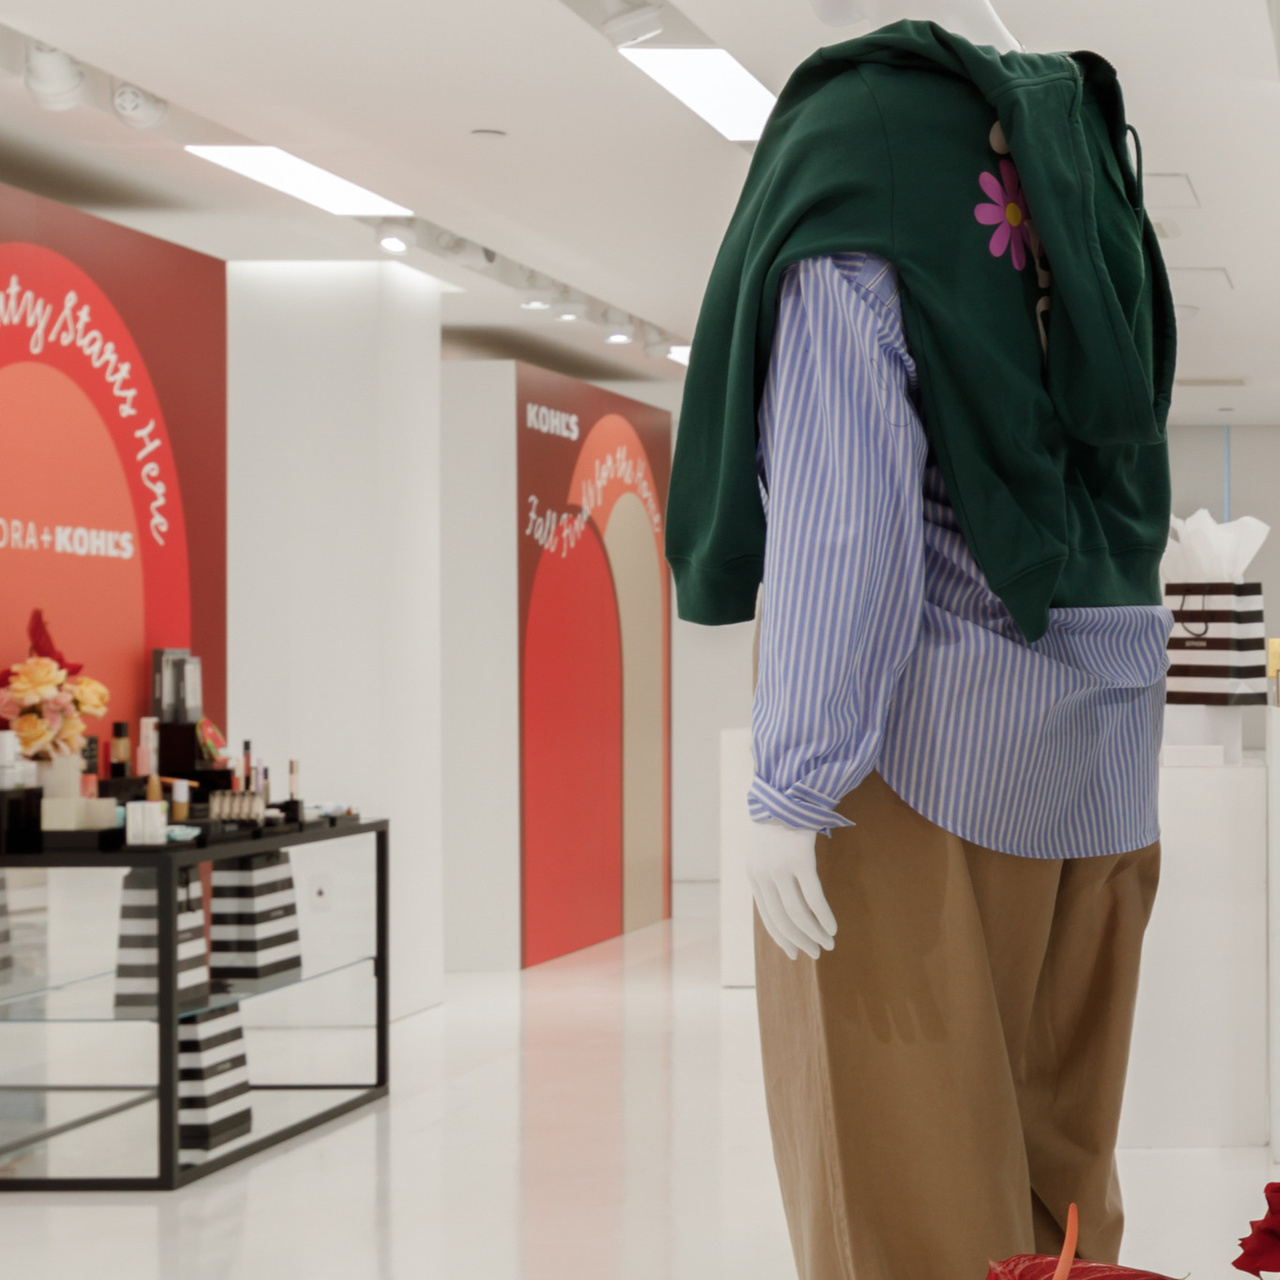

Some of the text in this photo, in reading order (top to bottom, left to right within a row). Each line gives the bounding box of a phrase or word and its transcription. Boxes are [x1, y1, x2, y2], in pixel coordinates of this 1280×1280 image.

[48, 290, 138, 418] Starts
[134, 419, 169, 547] Here
[526, 403, 580, 441] KOHL'S
[525, 494, 558, 553] Fall
